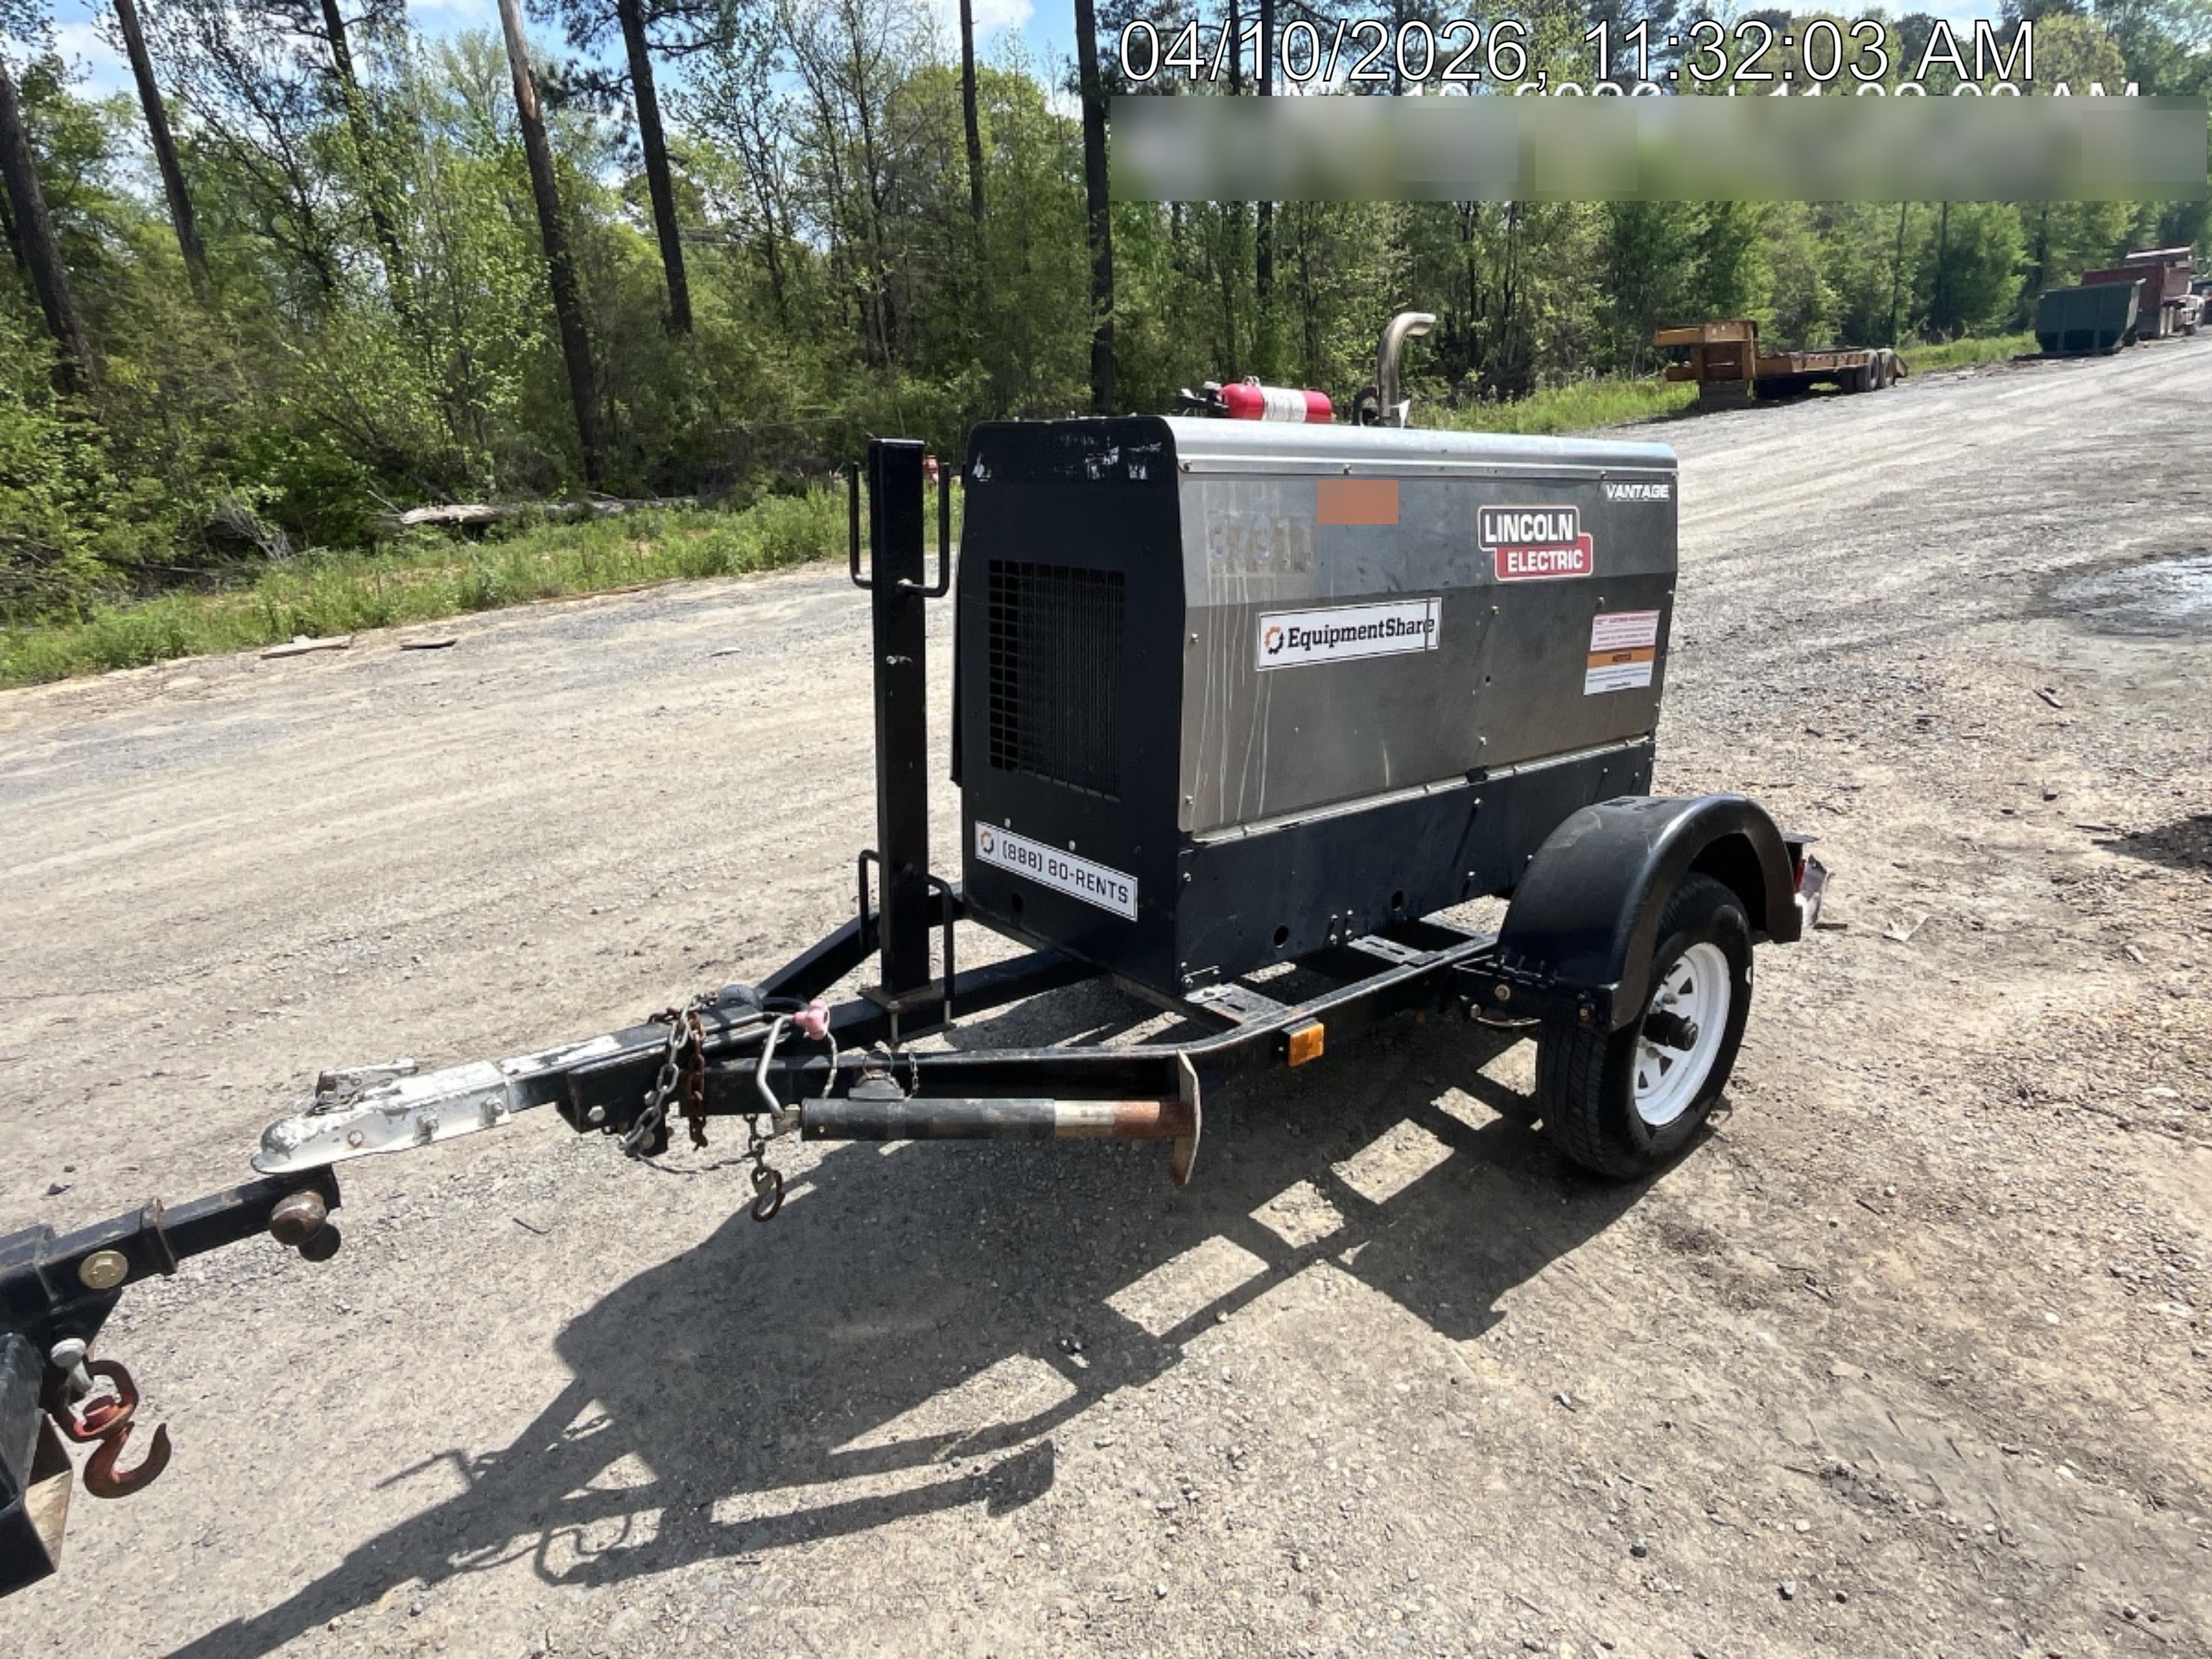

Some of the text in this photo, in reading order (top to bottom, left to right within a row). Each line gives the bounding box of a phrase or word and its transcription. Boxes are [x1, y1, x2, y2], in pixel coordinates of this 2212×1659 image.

[1606, 484, 1669, 500] VANTAGE
[1484, 514, 1574, 542] LINCOLN
[1507, 549, 1583, 573] ELECTRIC
[1288, 618, 1435, 651] EquipmentShare
[1002, 840, 1129, 904] (888) 80-RENTS
